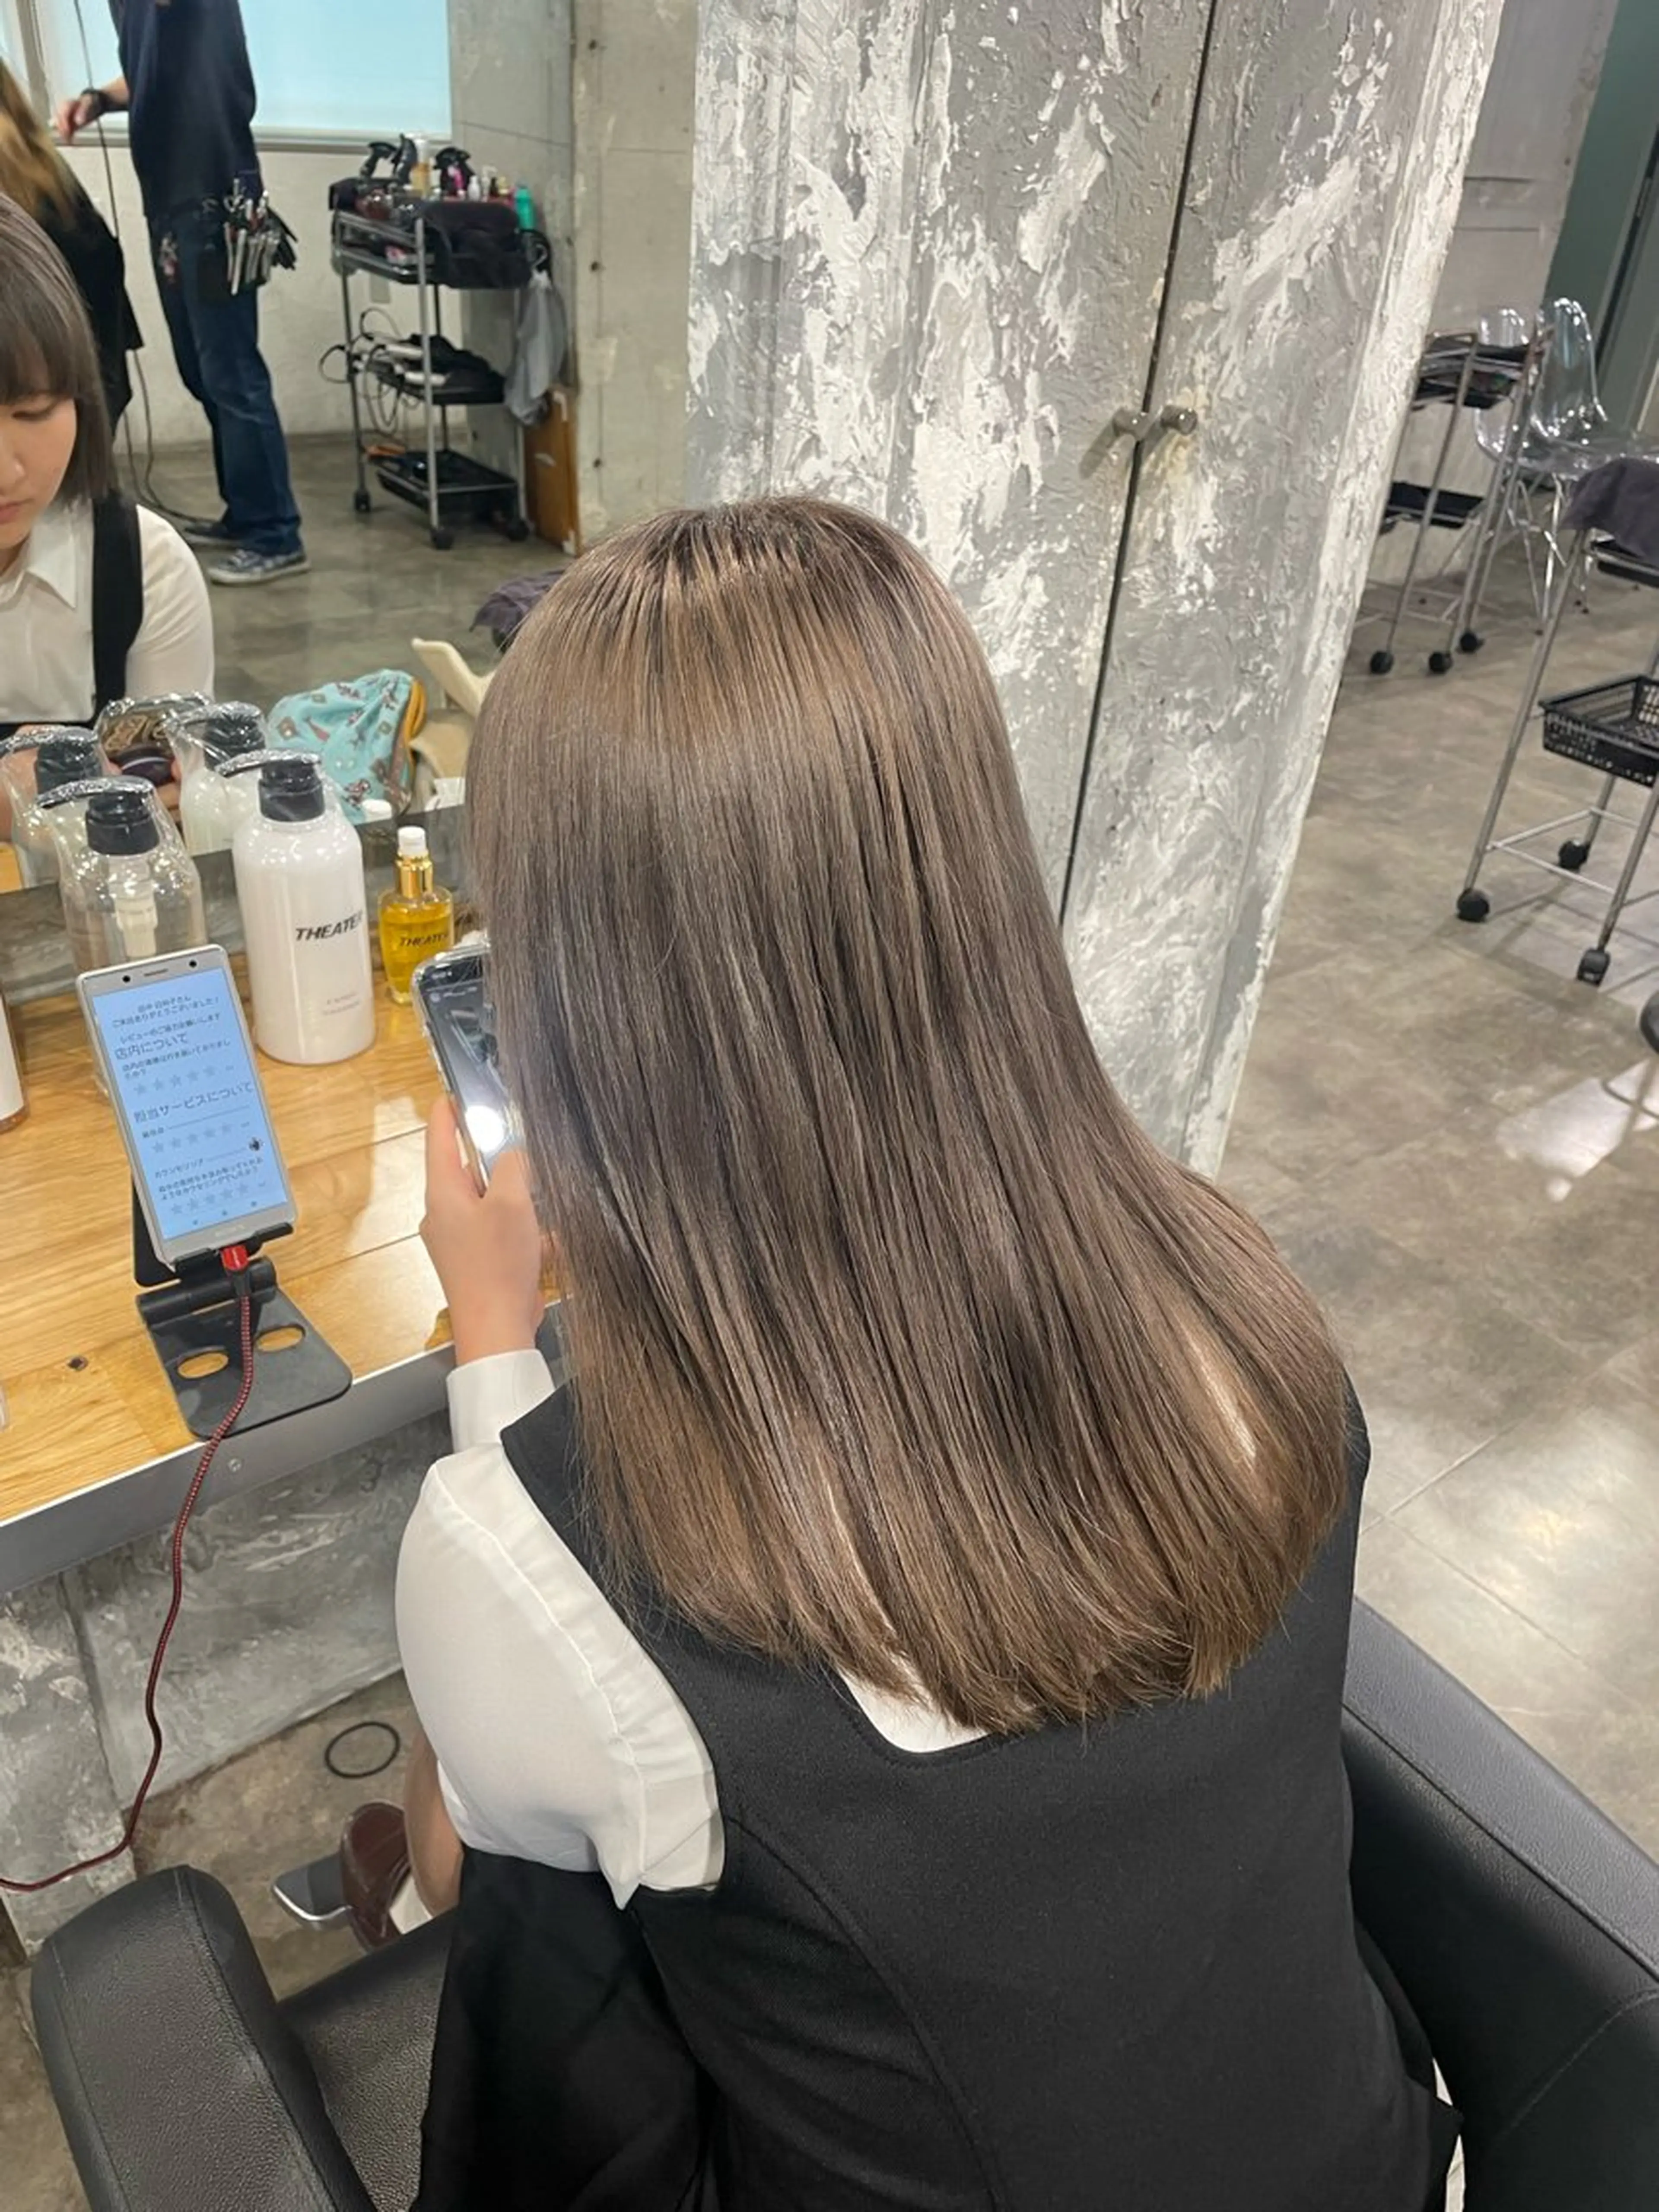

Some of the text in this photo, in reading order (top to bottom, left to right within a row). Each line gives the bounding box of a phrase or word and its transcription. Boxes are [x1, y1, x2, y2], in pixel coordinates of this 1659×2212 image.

[114, 1033, 188, 1059] 店内について
[134, 1081, 254, 1122] 担当サービスについて
